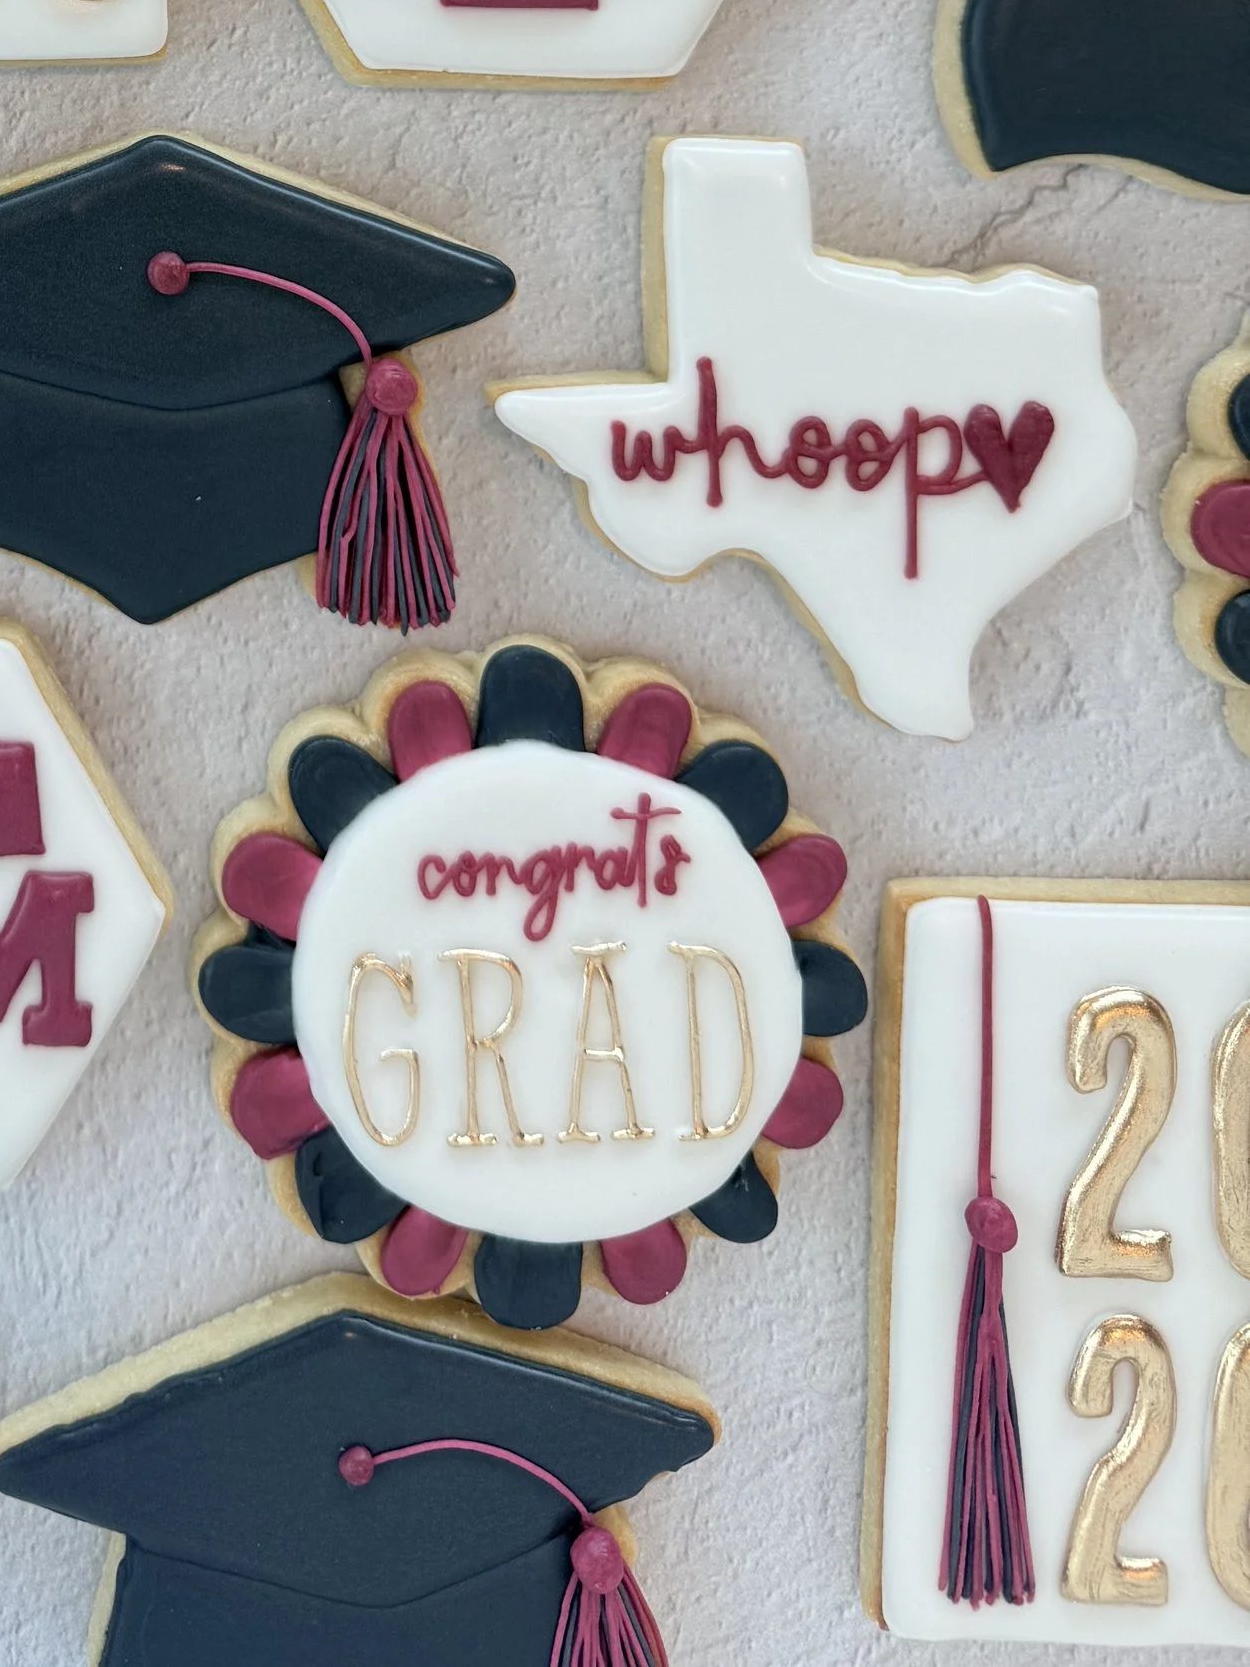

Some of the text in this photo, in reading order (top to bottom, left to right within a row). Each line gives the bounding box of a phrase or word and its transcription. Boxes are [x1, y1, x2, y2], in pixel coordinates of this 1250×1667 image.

[610, 356, 970, 580] whoop
[416, 792, 693, 943] congrats
[342, 939, 755, 1149] GRAD
